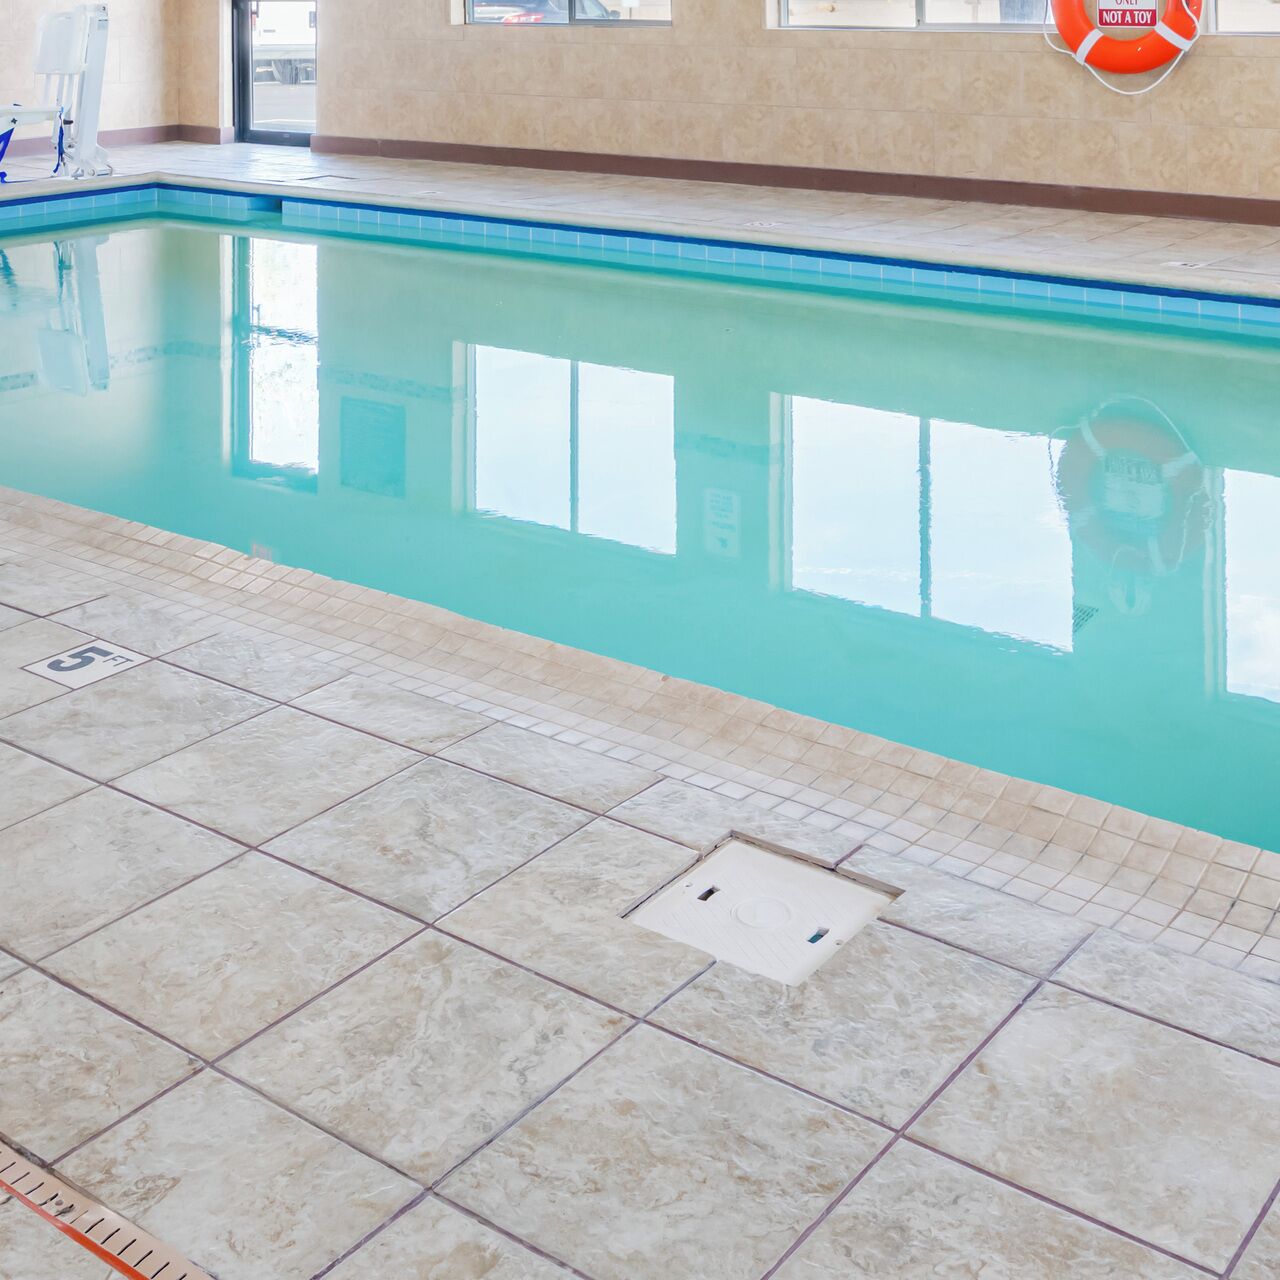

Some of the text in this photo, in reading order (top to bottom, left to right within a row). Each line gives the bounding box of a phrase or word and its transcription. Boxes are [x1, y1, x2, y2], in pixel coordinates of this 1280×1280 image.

[1102, 10, 1152, 24] NOT A TOY
[47, 646, 134, 672] 5 FT
